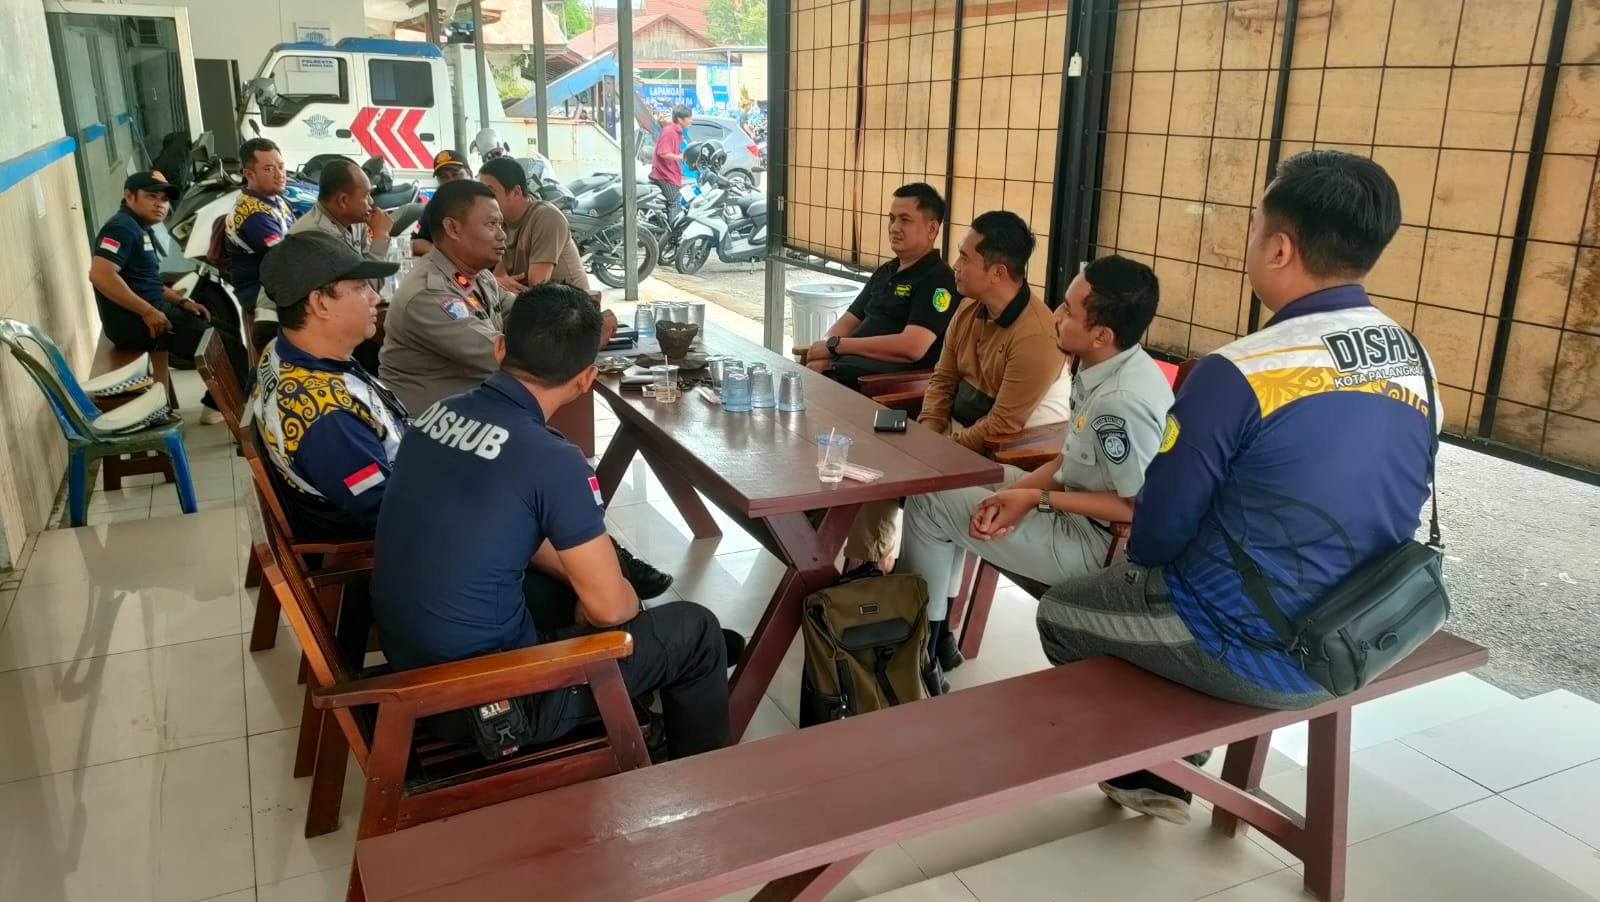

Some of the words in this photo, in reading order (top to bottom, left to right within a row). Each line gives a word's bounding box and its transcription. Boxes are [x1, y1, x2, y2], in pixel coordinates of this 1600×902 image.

[1322, 326, 1420, 372] DISHU
[1334, 375, 1368, 389] KOTA
[413, 401, 510, 460] DISHUB
